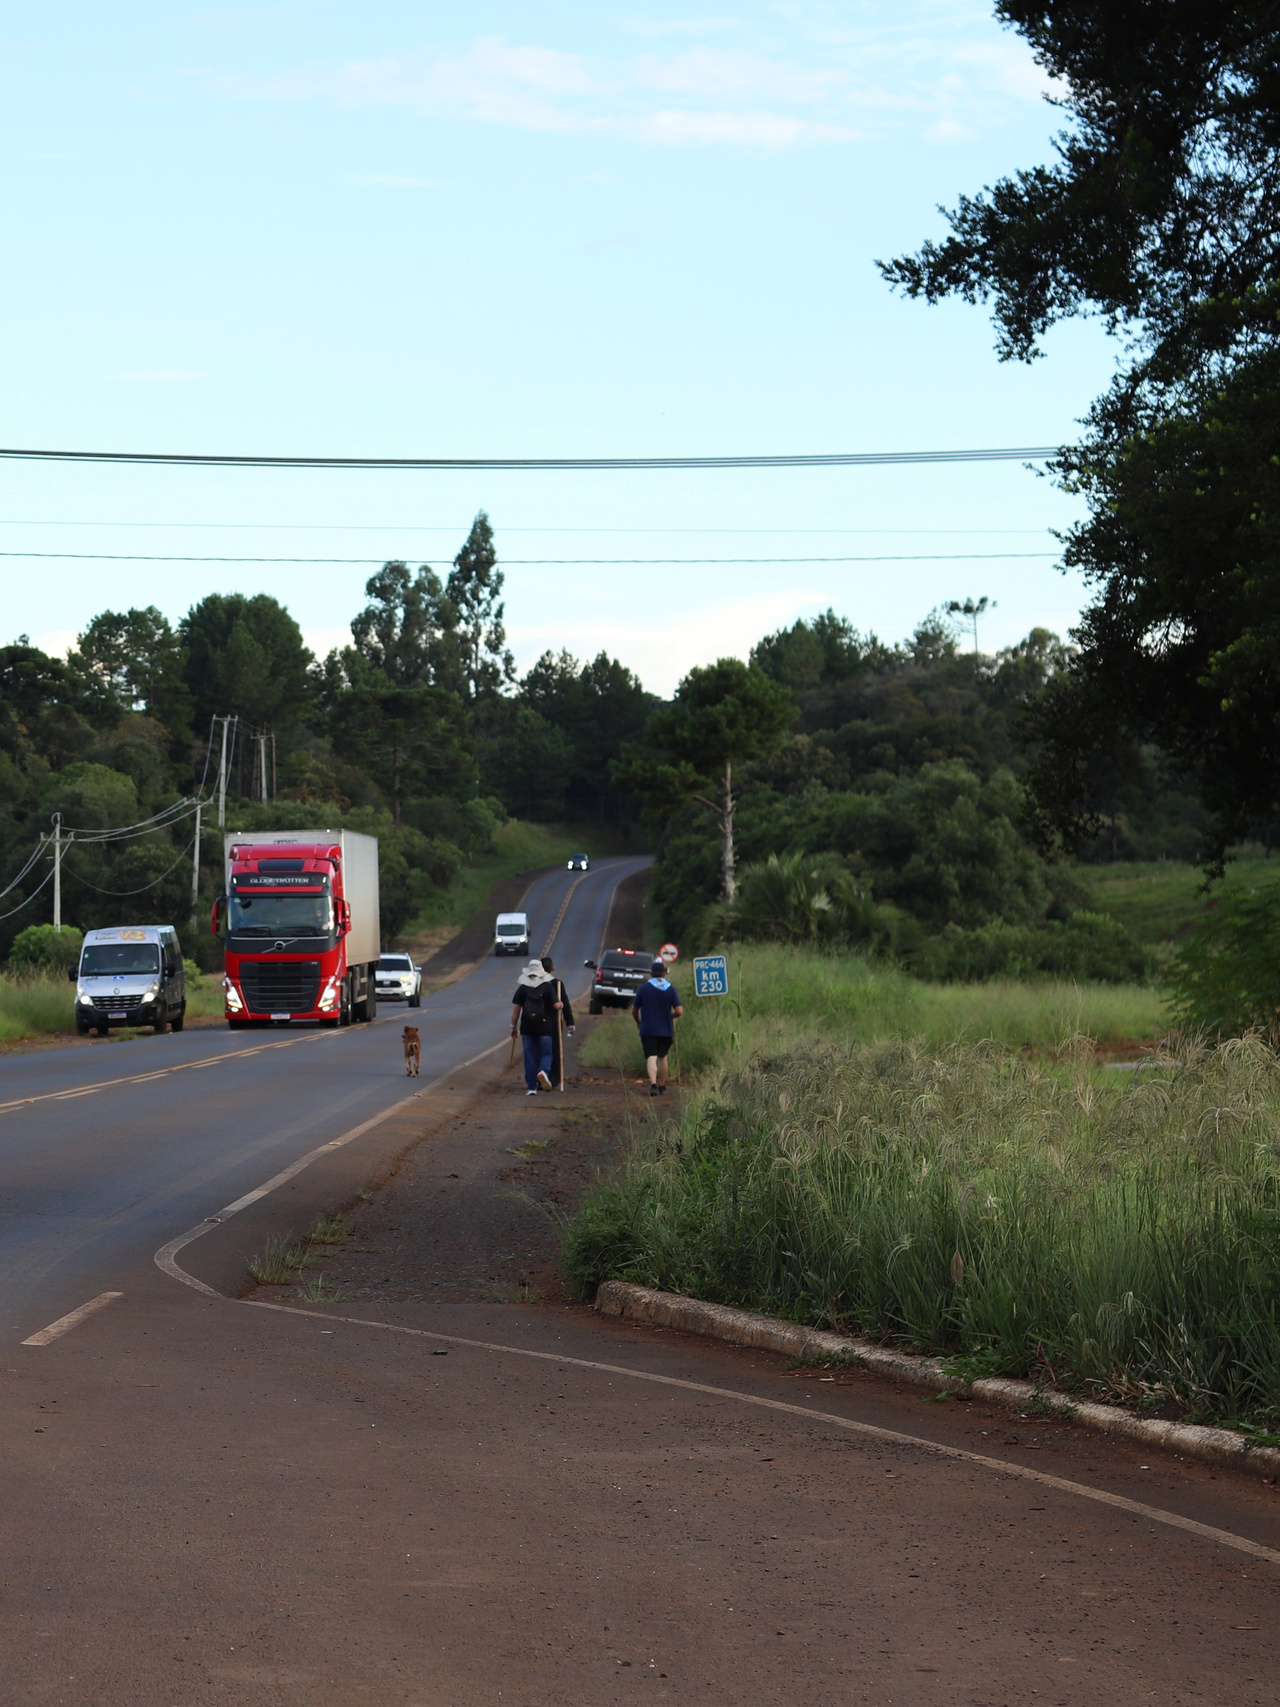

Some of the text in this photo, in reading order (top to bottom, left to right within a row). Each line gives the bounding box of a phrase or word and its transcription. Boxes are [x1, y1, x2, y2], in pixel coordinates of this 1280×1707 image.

[695, 959, 725, 970] PRC-466
[702, 970, 719, 981] km
[701, 980, 723, 992] 230
